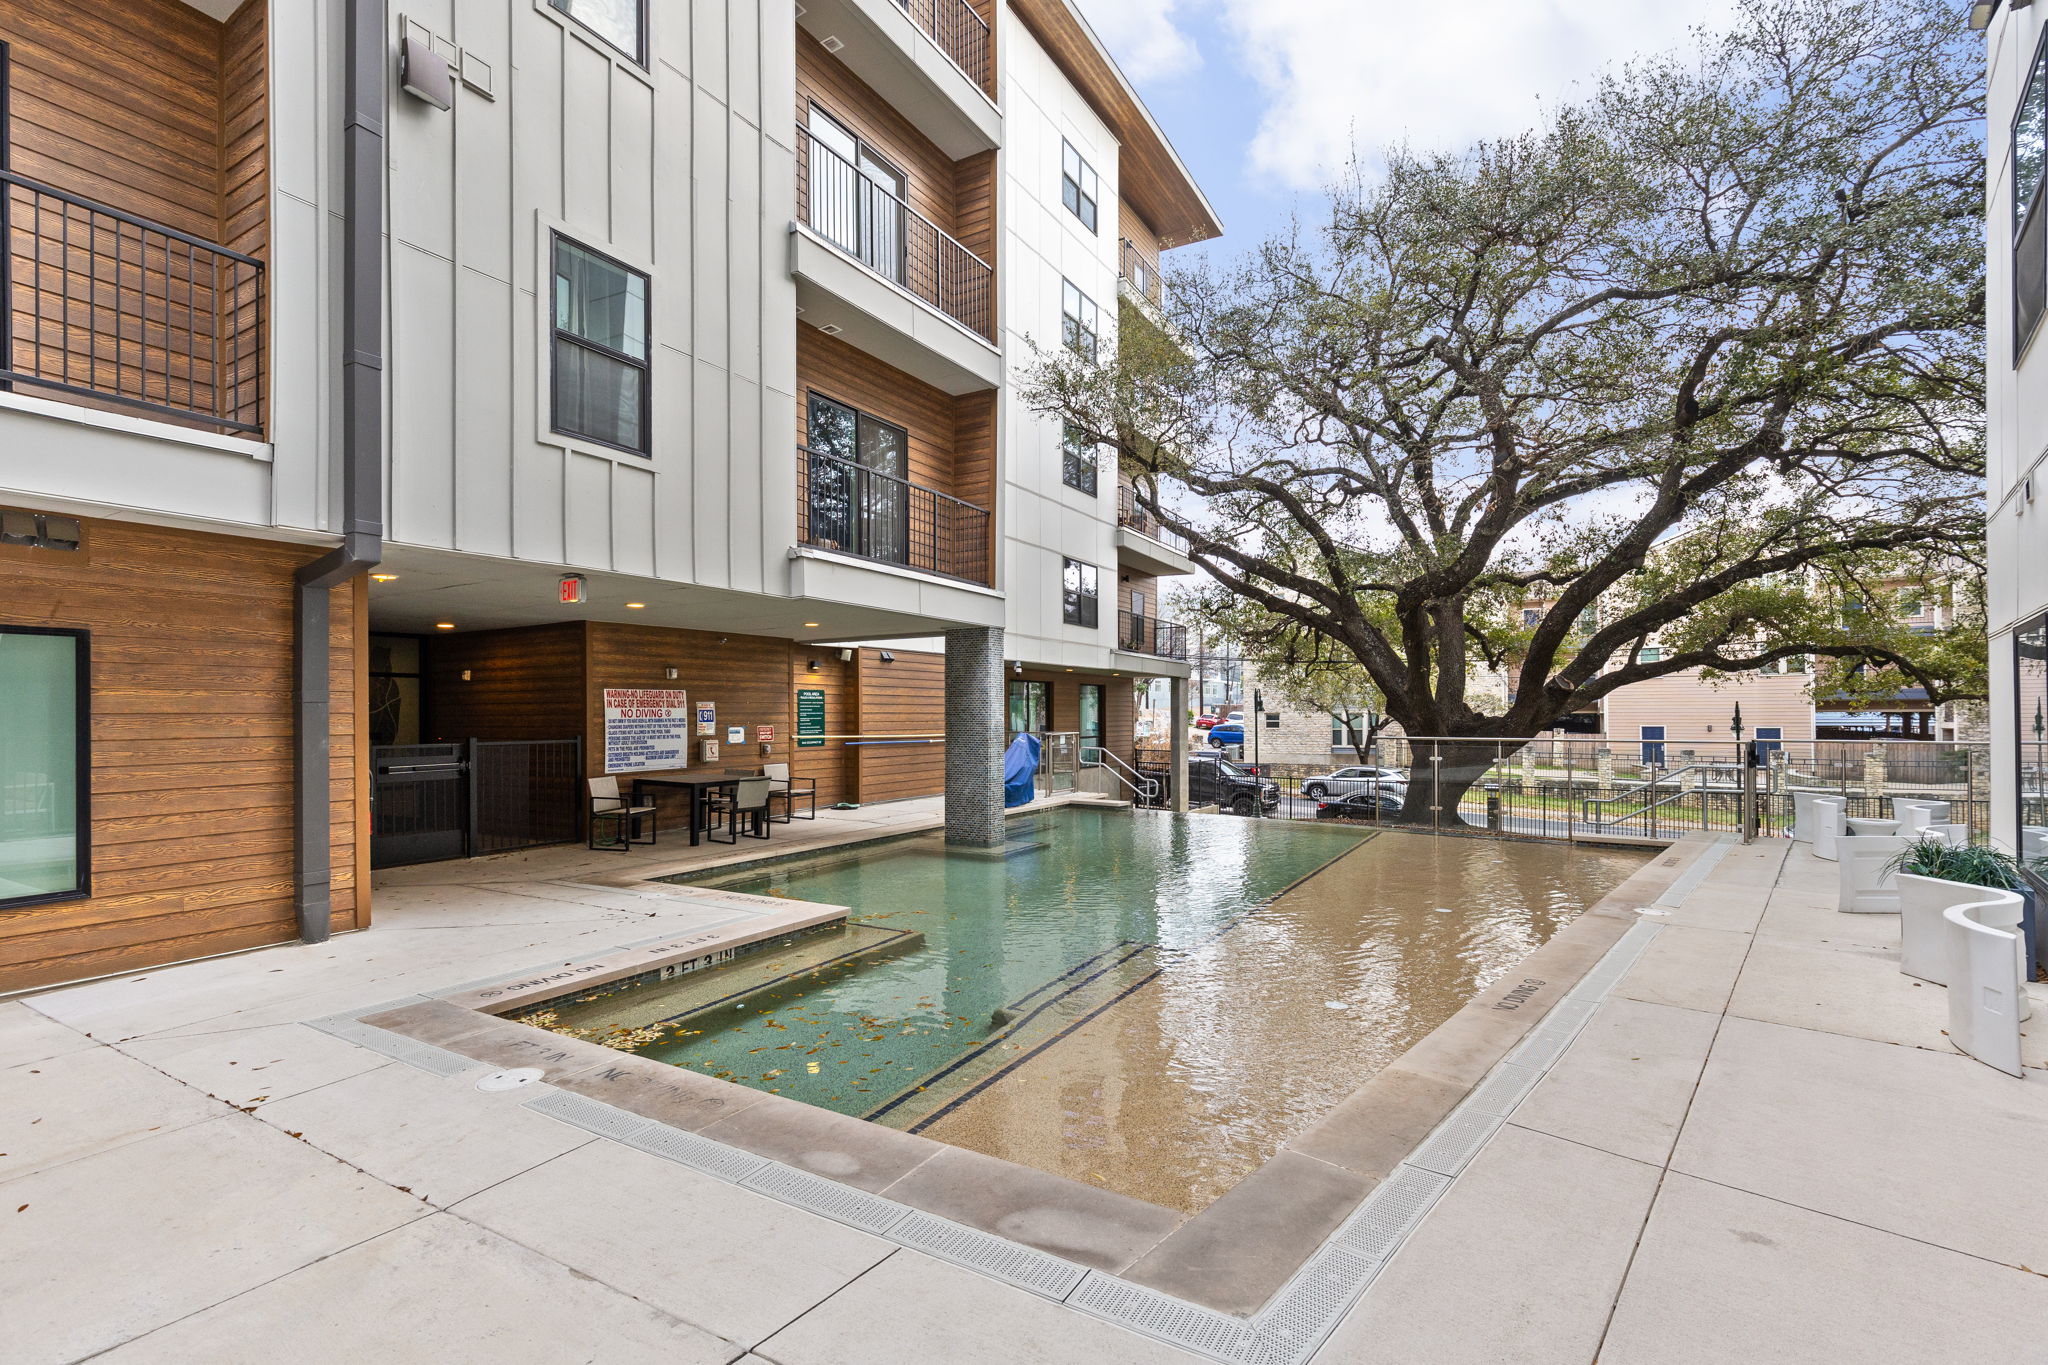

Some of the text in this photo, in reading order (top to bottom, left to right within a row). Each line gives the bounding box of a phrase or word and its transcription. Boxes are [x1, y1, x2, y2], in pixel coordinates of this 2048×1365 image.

[562, 580, 577, 600] EXIT
[639, 690, 664, 699] LIFEGUARD
[665, 691, 672, 699] ON
[673, 691, 684, 699] DUTY
[606, 699, 685, 708] IN CASE OF EMERGENCY DIAL 911
[621, 709, 663, 718] NO DIVING
[704, 711, 713, 720] 911
[682, 958, 697, 972] FT
[720, 948, 732, 961] IN
[507, 964, 605, 991] NO DIVING
[1492, 985, 1539, 1010] NO DIVING
